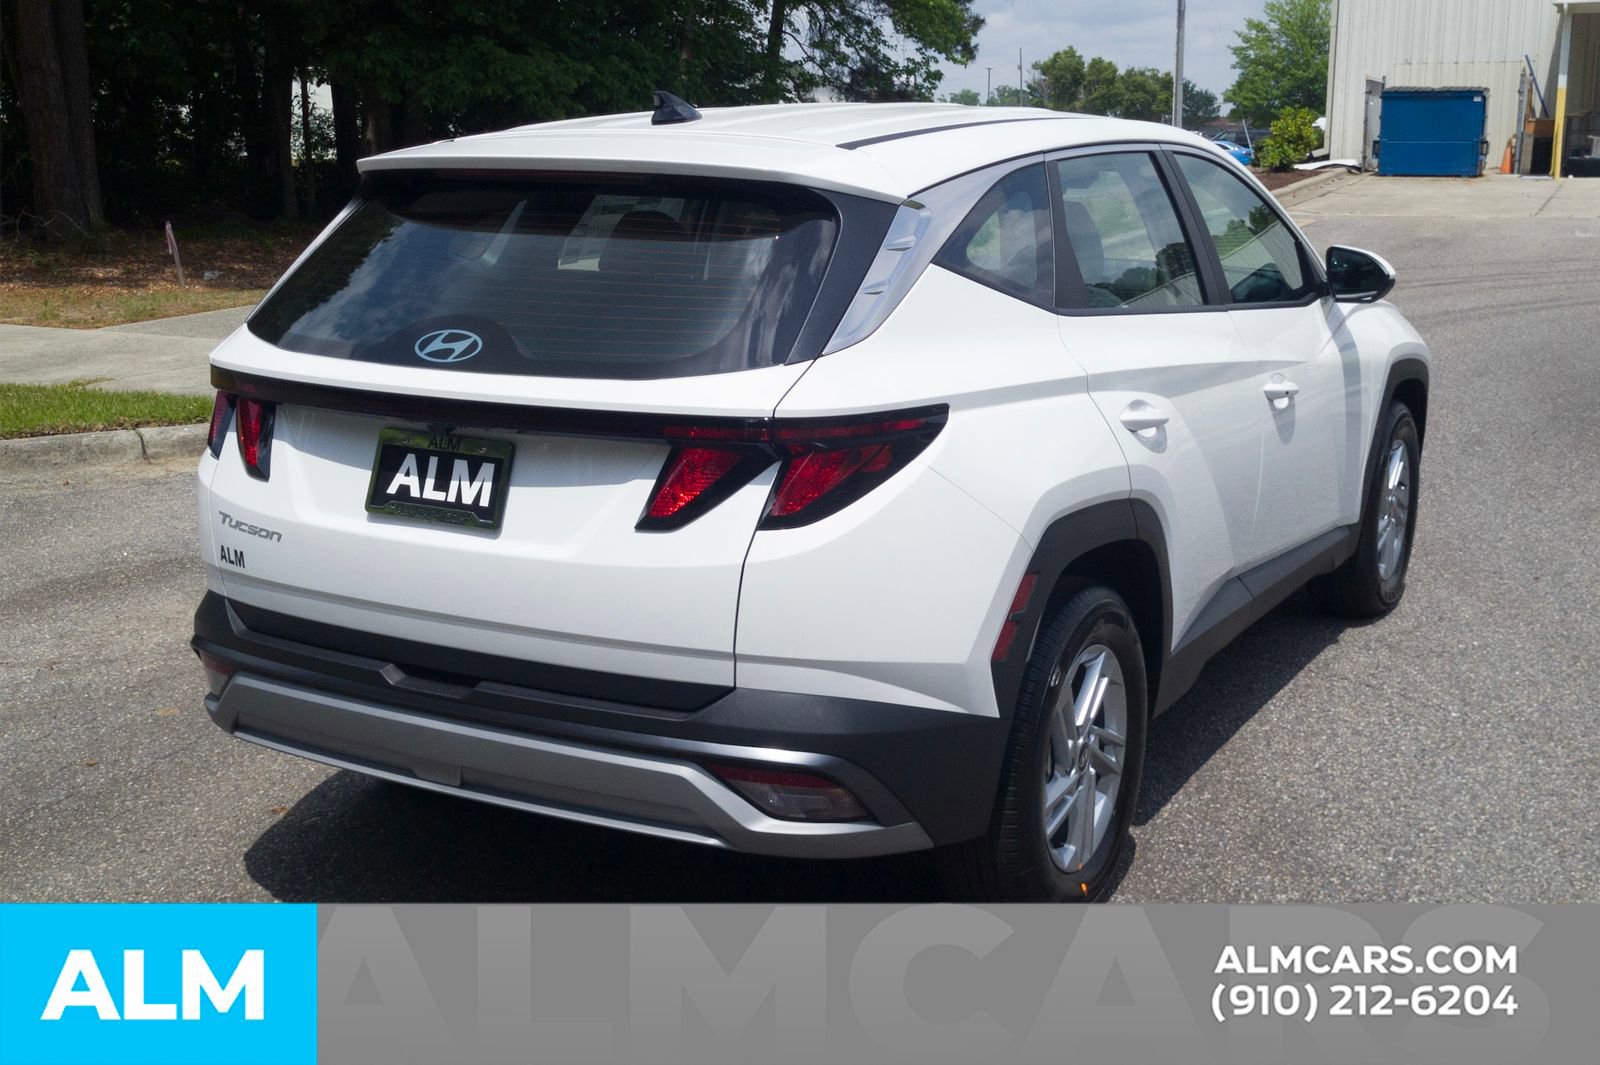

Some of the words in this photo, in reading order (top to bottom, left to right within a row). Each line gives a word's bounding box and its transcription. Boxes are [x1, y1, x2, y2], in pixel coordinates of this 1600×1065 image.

[428, 435, 462, 451] ALM
[386, 453, 495, 508] ALM
[220, 545, 246, 569] ALM
